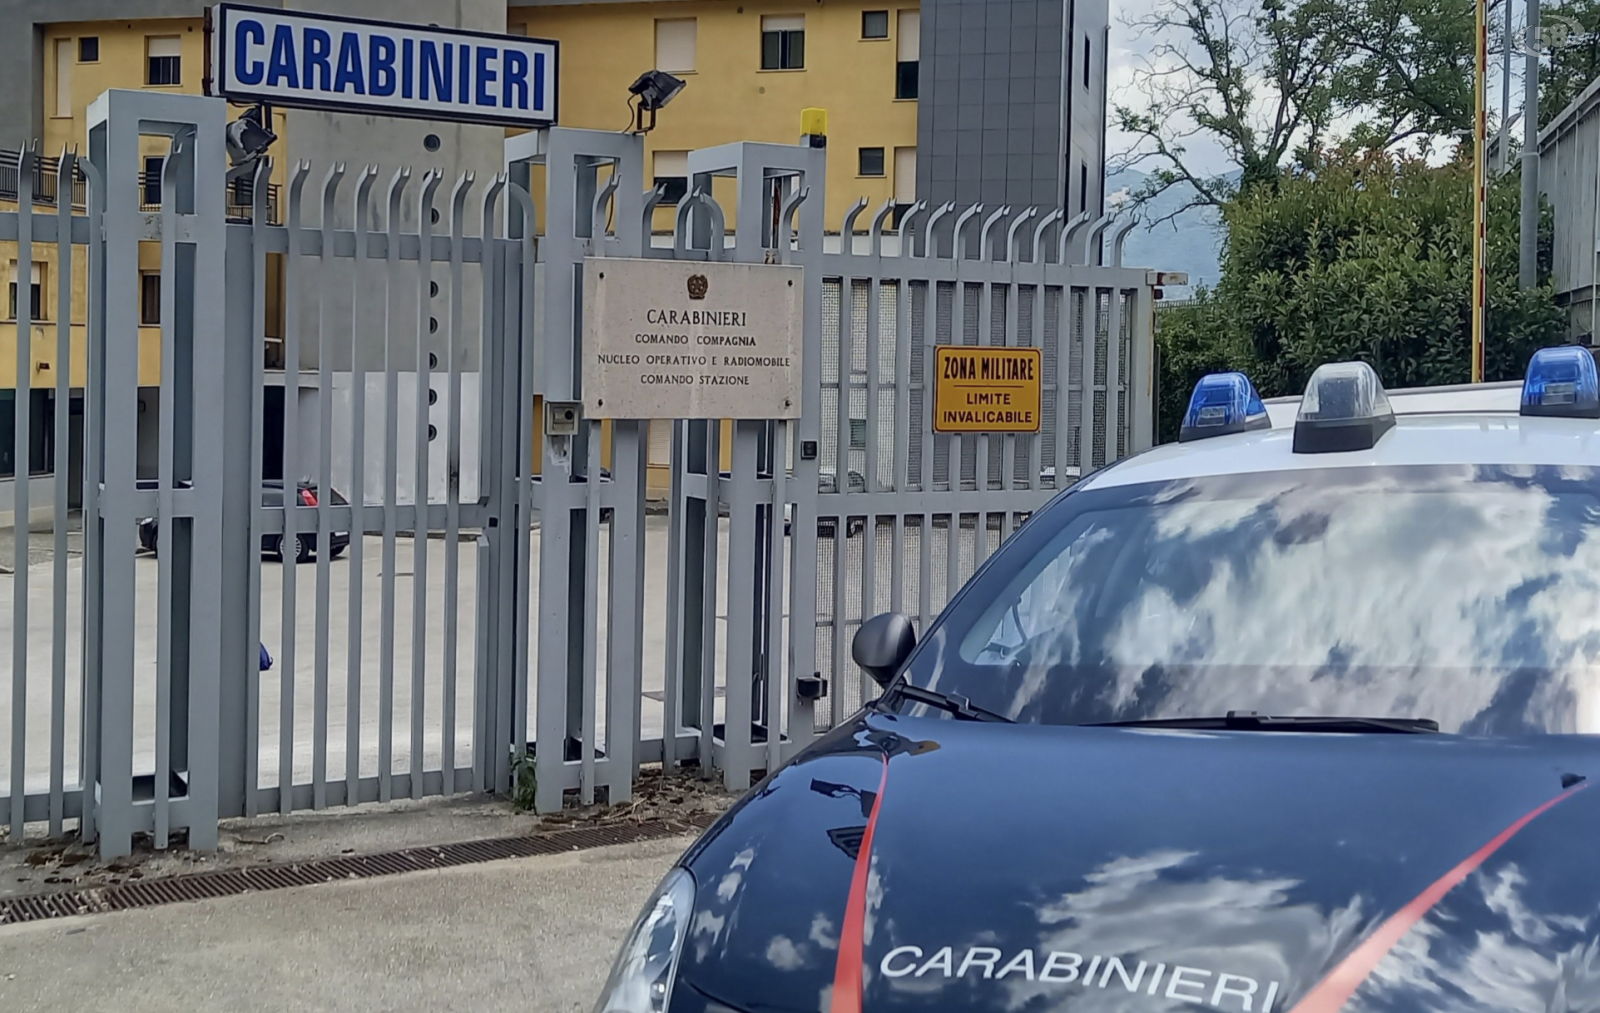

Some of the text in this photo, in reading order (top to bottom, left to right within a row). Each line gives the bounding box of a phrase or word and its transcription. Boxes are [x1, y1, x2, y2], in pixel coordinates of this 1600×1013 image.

[235, 19, 545, 111] CARABINIERI
[647, 309, 746, 326] CARABINIERI
[635, 334, 756, 346] COMANDO COMPAGNIA
[598, 354, 790, 367] NUCLEO OPERATIVO E RADIOMOBILE
[944, 356, 1034, 380] ZONA MILITARE
[640, 374, 749, 385] COMANDO STAZIONE
[966, 393, 1011, 405] LIMITE
[943, 411, 1032, 423] INVALICABILE
[880, 945, 1279, 1013] CARABINIERI
